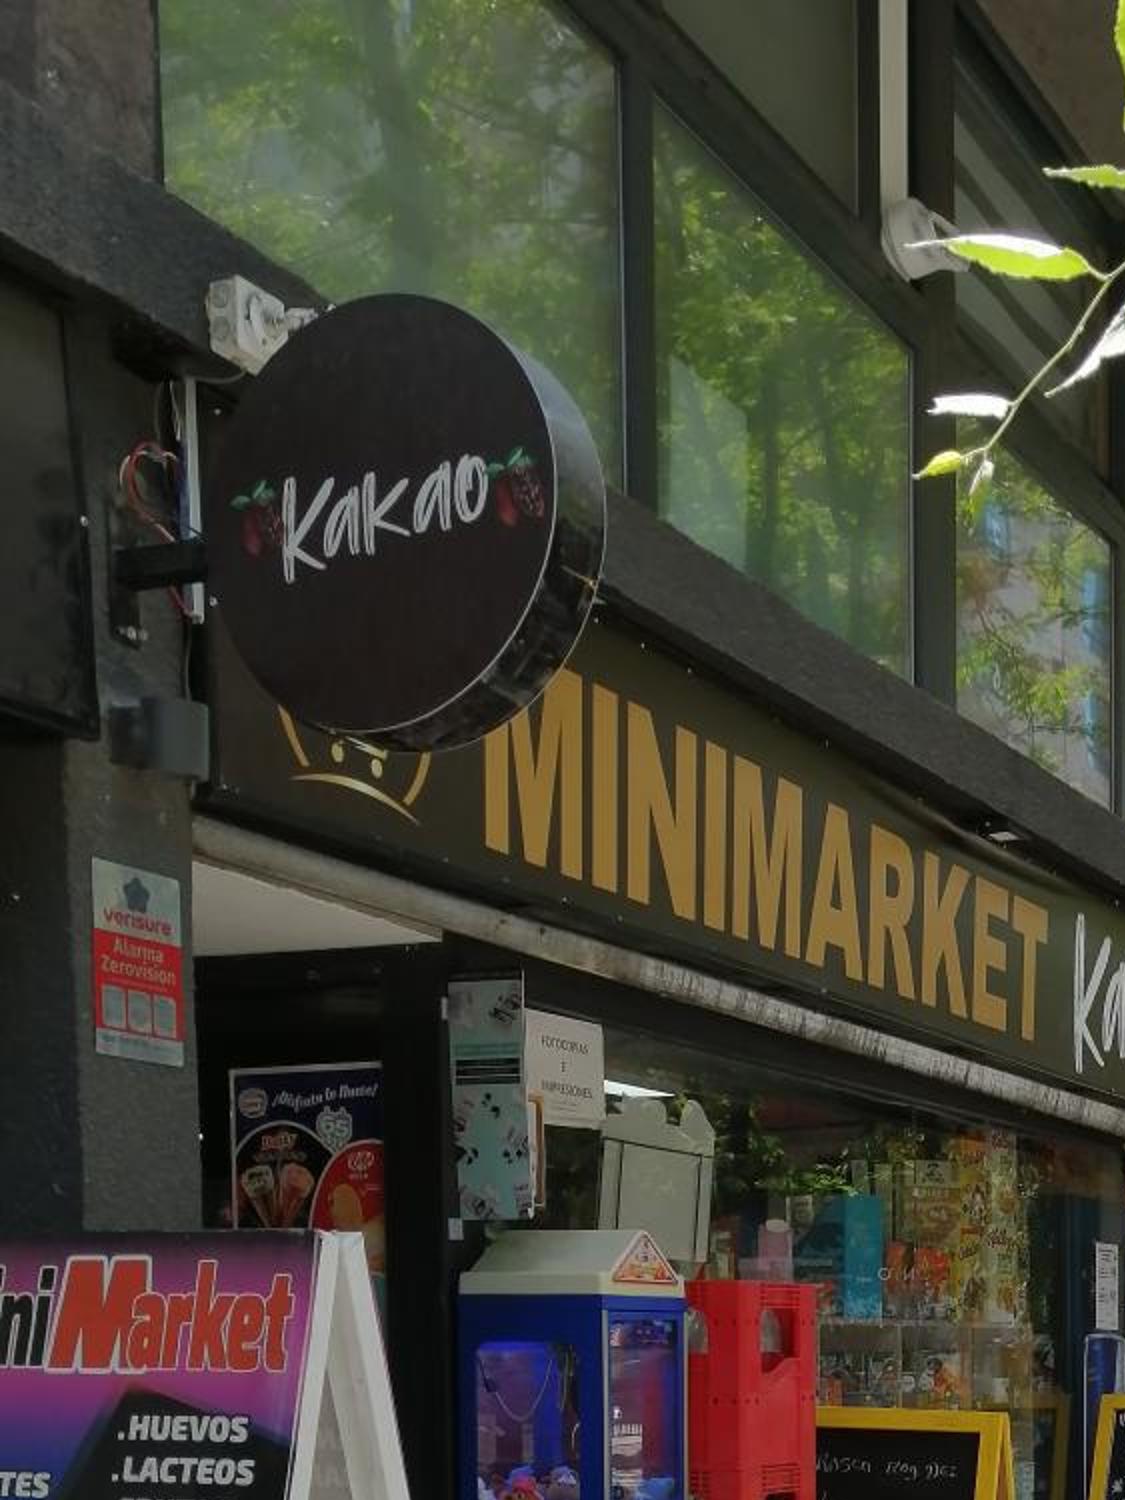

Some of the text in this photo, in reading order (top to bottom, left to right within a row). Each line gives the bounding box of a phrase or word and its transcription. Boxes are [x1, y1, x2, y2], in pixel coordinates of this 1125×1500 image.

[282, 454, 488, 583] Kakao
[484, 668, 1049, 1041] MINIMARKET
[104, 907, 171, 935] verisure
[0, 1254, 294, 1374] niMarket
